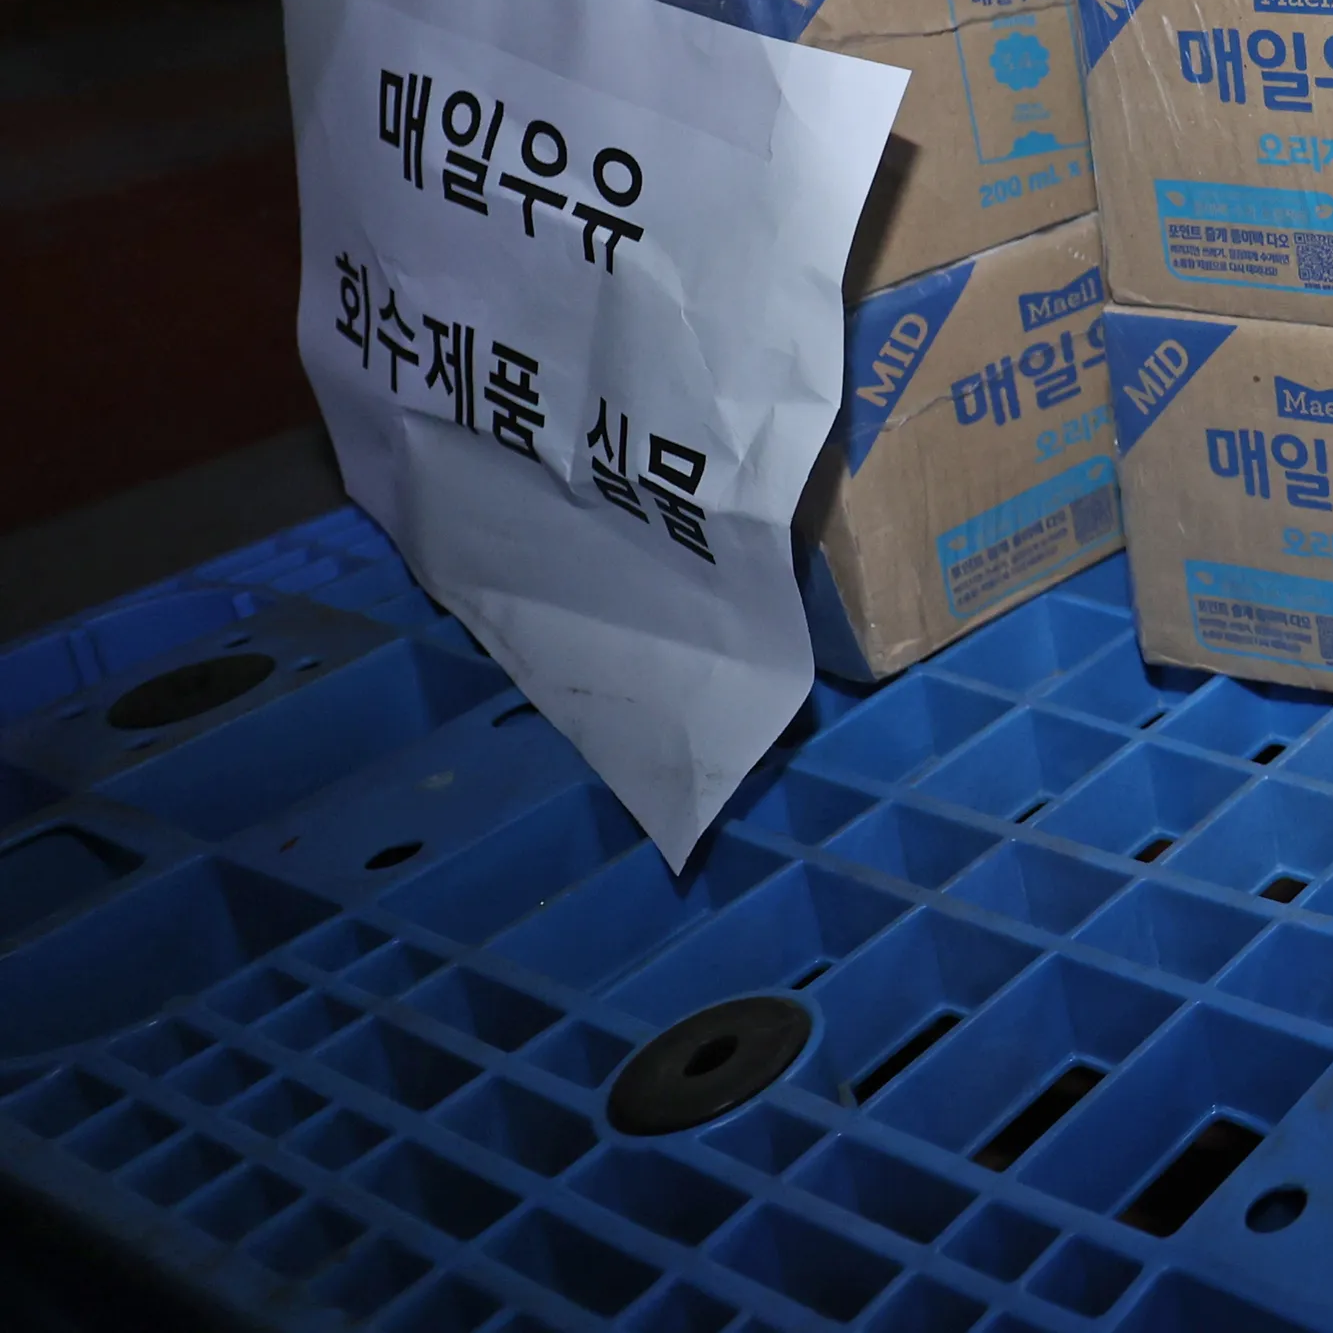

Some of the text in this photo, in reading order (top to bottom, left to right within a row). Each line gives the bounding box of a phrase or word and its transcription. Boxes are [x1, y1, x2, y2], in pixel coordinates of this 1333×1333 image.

[377, 68, 644, 274] 매일우유
[979, 175, 1022, 209] 200
[1028, 163, 1063, 192] mL
[1026, 280, 1098, 325] Maeil
[856, 313, 928, 407] MID
[1122, 338, 1190, 416] MID
[333, 250, 717, 566] 회수제품 실물
